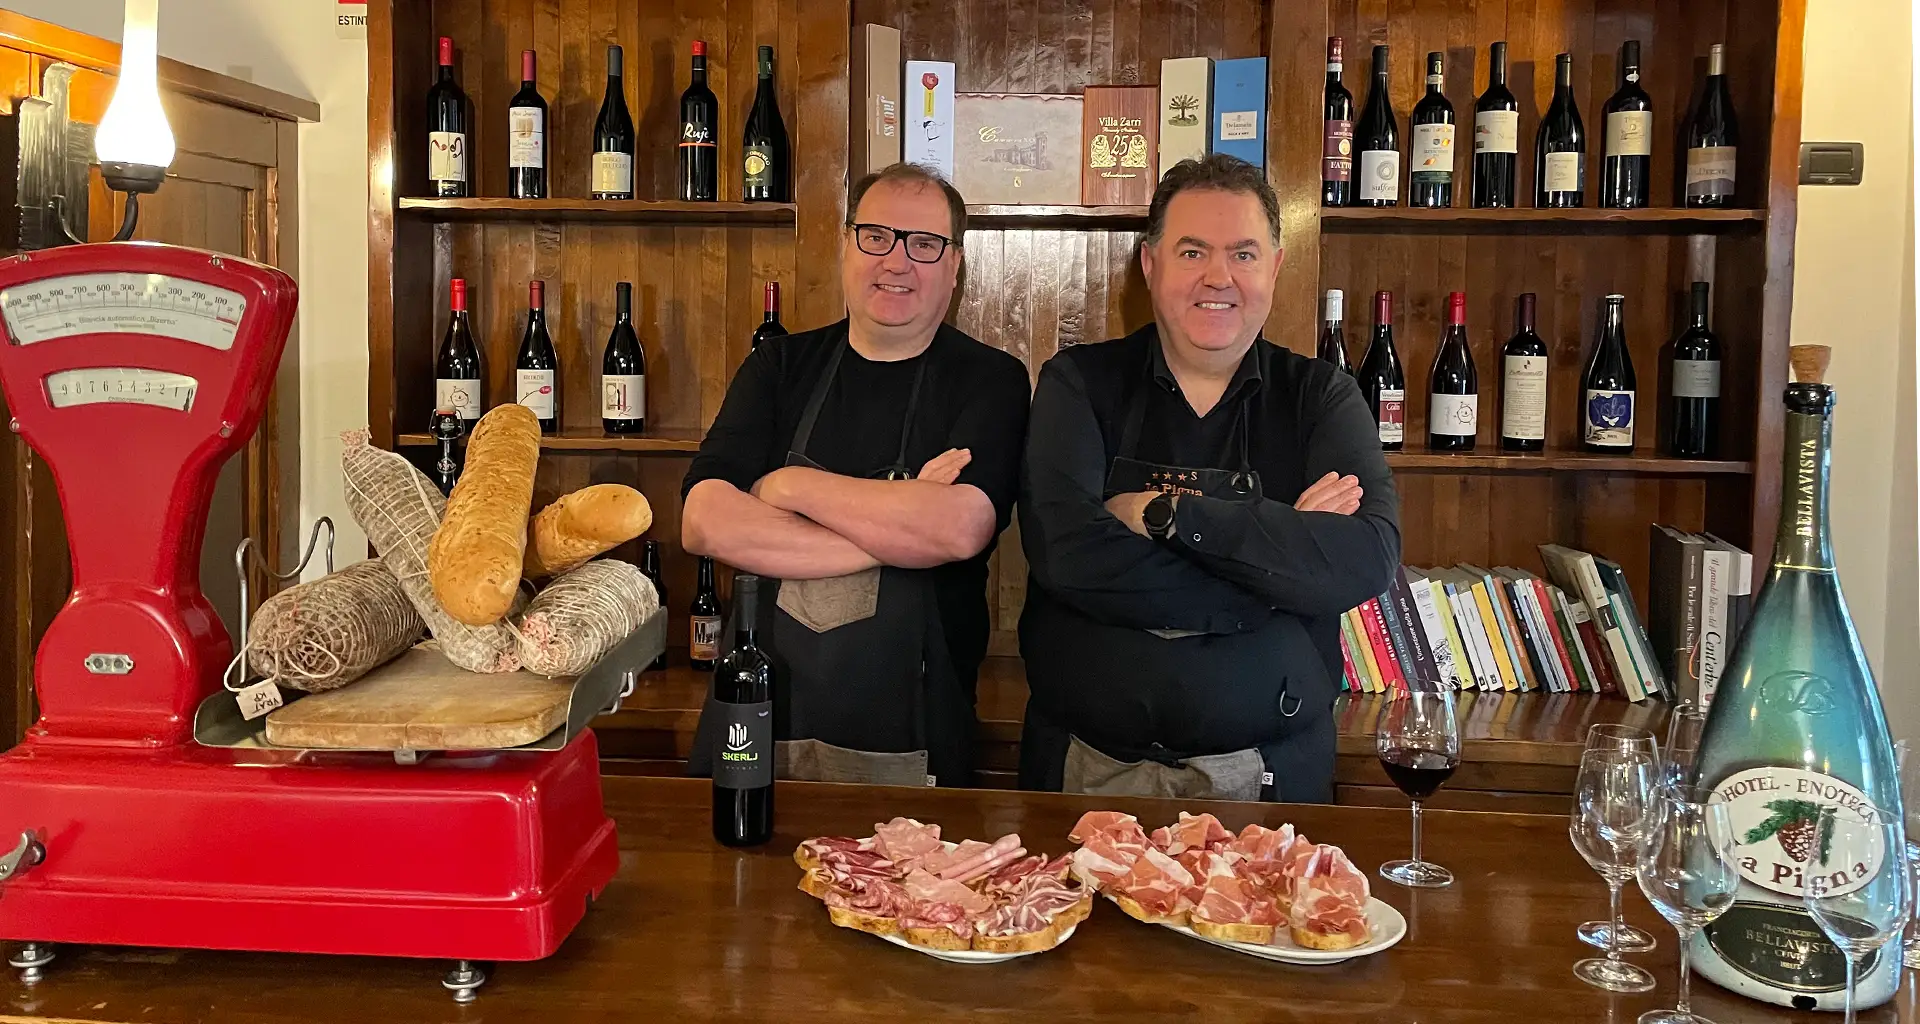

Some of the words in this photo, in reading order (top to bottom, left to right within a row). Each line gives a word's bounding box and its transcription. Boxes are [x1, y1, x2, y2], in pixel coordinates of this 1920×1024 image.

[1098, 116, 1119, 127] Villa
[1119, 116, 1142, 127] Zarri
[1110, 135, 1130, 156] 25
[26, 293, 42, 302] 900
[49, 288, 64, 297] 800
[72, 285, 87, 295] 700
[96, 283, 111, 292] 600
[120, 283, 135, 291] 500
[167, 287, 183, 296] 300
[191, 291, 206, 300] 200
[214, 296, 228, 306] 100
[61, 384, 68, 396] 9
[76, 381, 82, 394] 8
[89, 380, 95, 393] 7
[103, 380, 109, 393] 6
[117, 380, 123, 393] 5
[130, 380, 136, 393] 4
[144, 382, 151, 394] 3
[159, 383, 166, 395] 2
[174, 386, 179, 398] 1
[1190, 471, 1198, 481] S
[1796, 439, 1817, 538] BELLAVISTA
[1687, 585, 1697, 598] Per
[251, 697, 280, 715] VRAT
[722, 751, 759, 762] SKERLJ
[1722, 776, 1780, 802] HOTEL
[1796, 778, 1875, 825] ENOTECA
[1769, 861, 1869, 899] Pigna
[1745, 928, 1839, 955] BELLAVISTA
